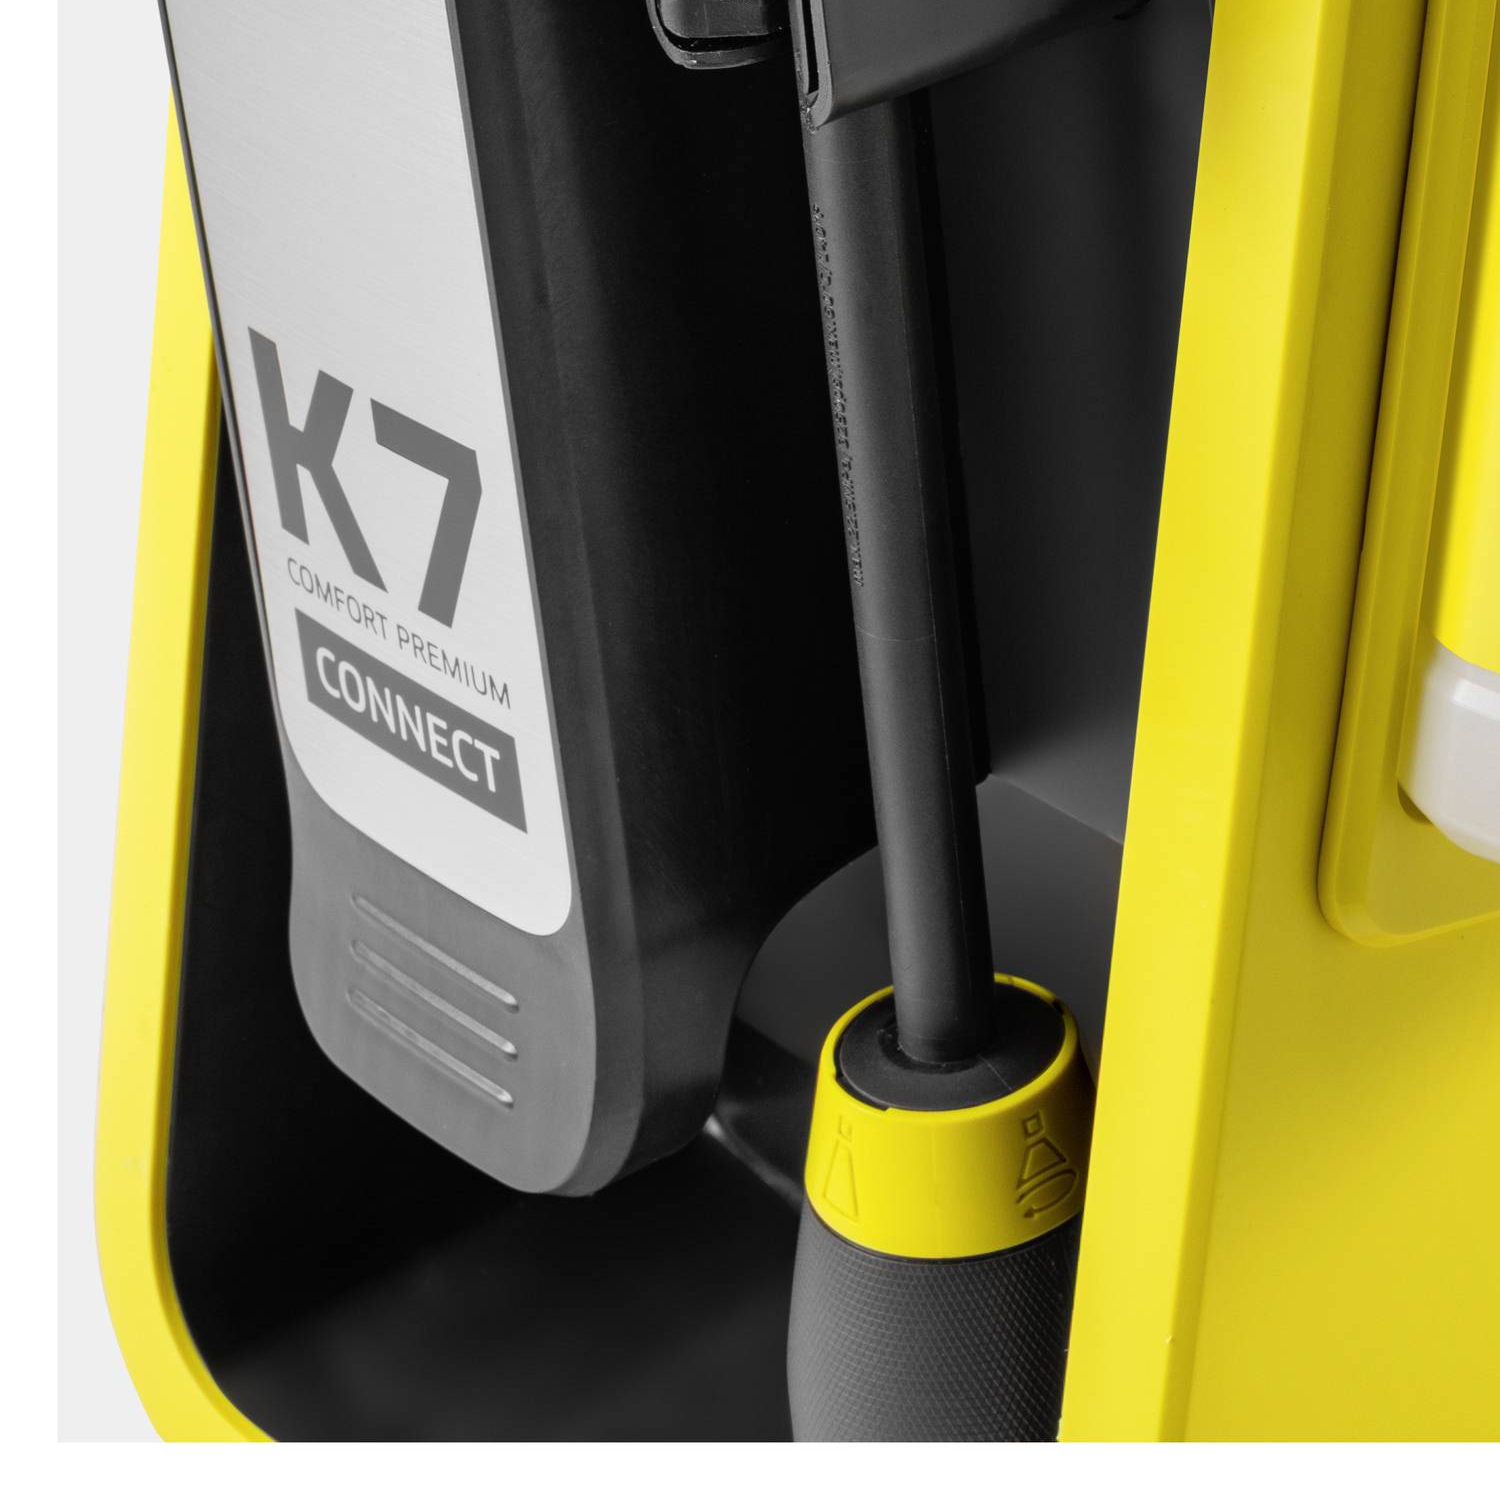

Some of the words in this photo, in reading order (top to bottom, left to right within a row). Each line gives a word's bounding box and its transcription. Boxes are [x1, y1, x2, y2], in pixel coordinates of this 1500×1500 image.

[247, 326, 482, 629] K7
[287, 557, 388, 640] COMFORT
[396, 623, 512, 711] PREMIUM
[316, 646, 501, 793] CONNECT
